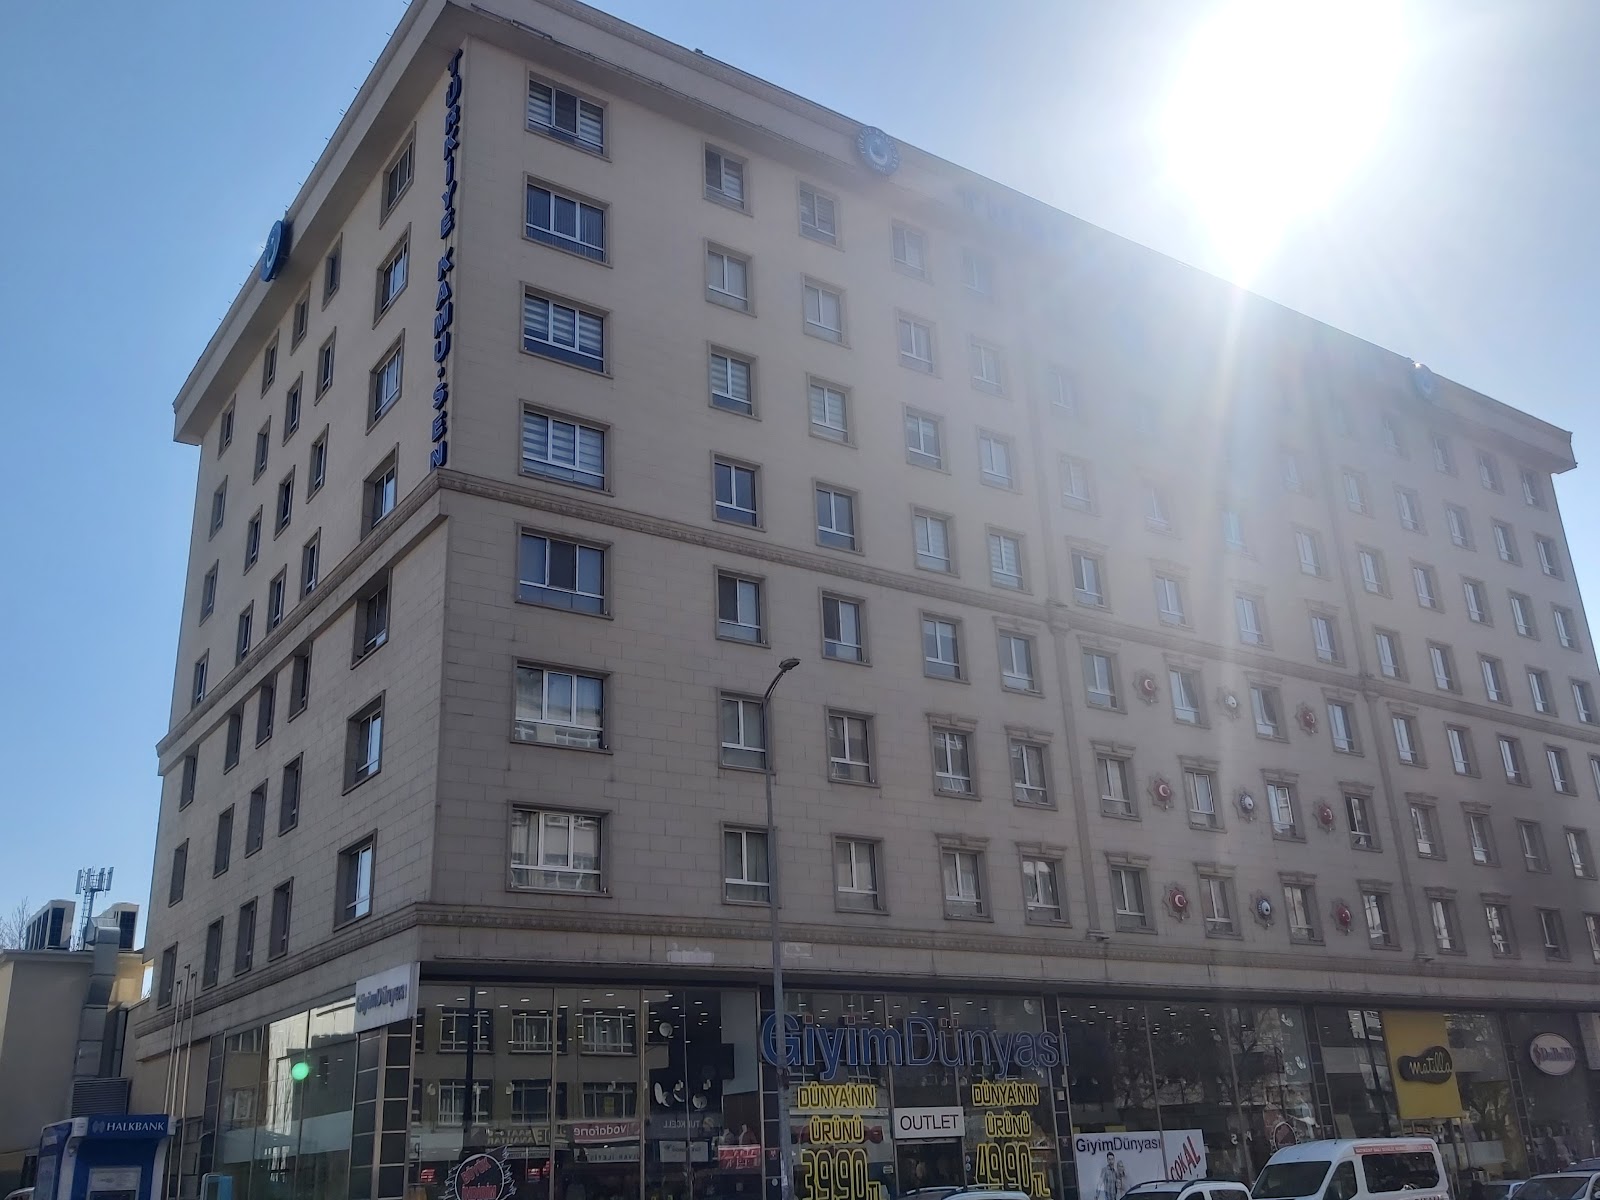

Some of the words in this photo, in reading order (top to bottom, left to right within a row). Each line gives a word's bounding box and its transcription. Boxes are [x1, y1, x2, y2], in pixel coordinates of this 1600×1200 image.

[761, 1012, 1071, 1081] GiyimDünyası
[106, 1121, 165, 1132] HALKBANK
[809, 1115, 865, 1144] ÜRÜNÜ
[900, 1114, 959, 1131] OUTLET
[985, 1110, 1032, 1138] ÜRÜNÜ
